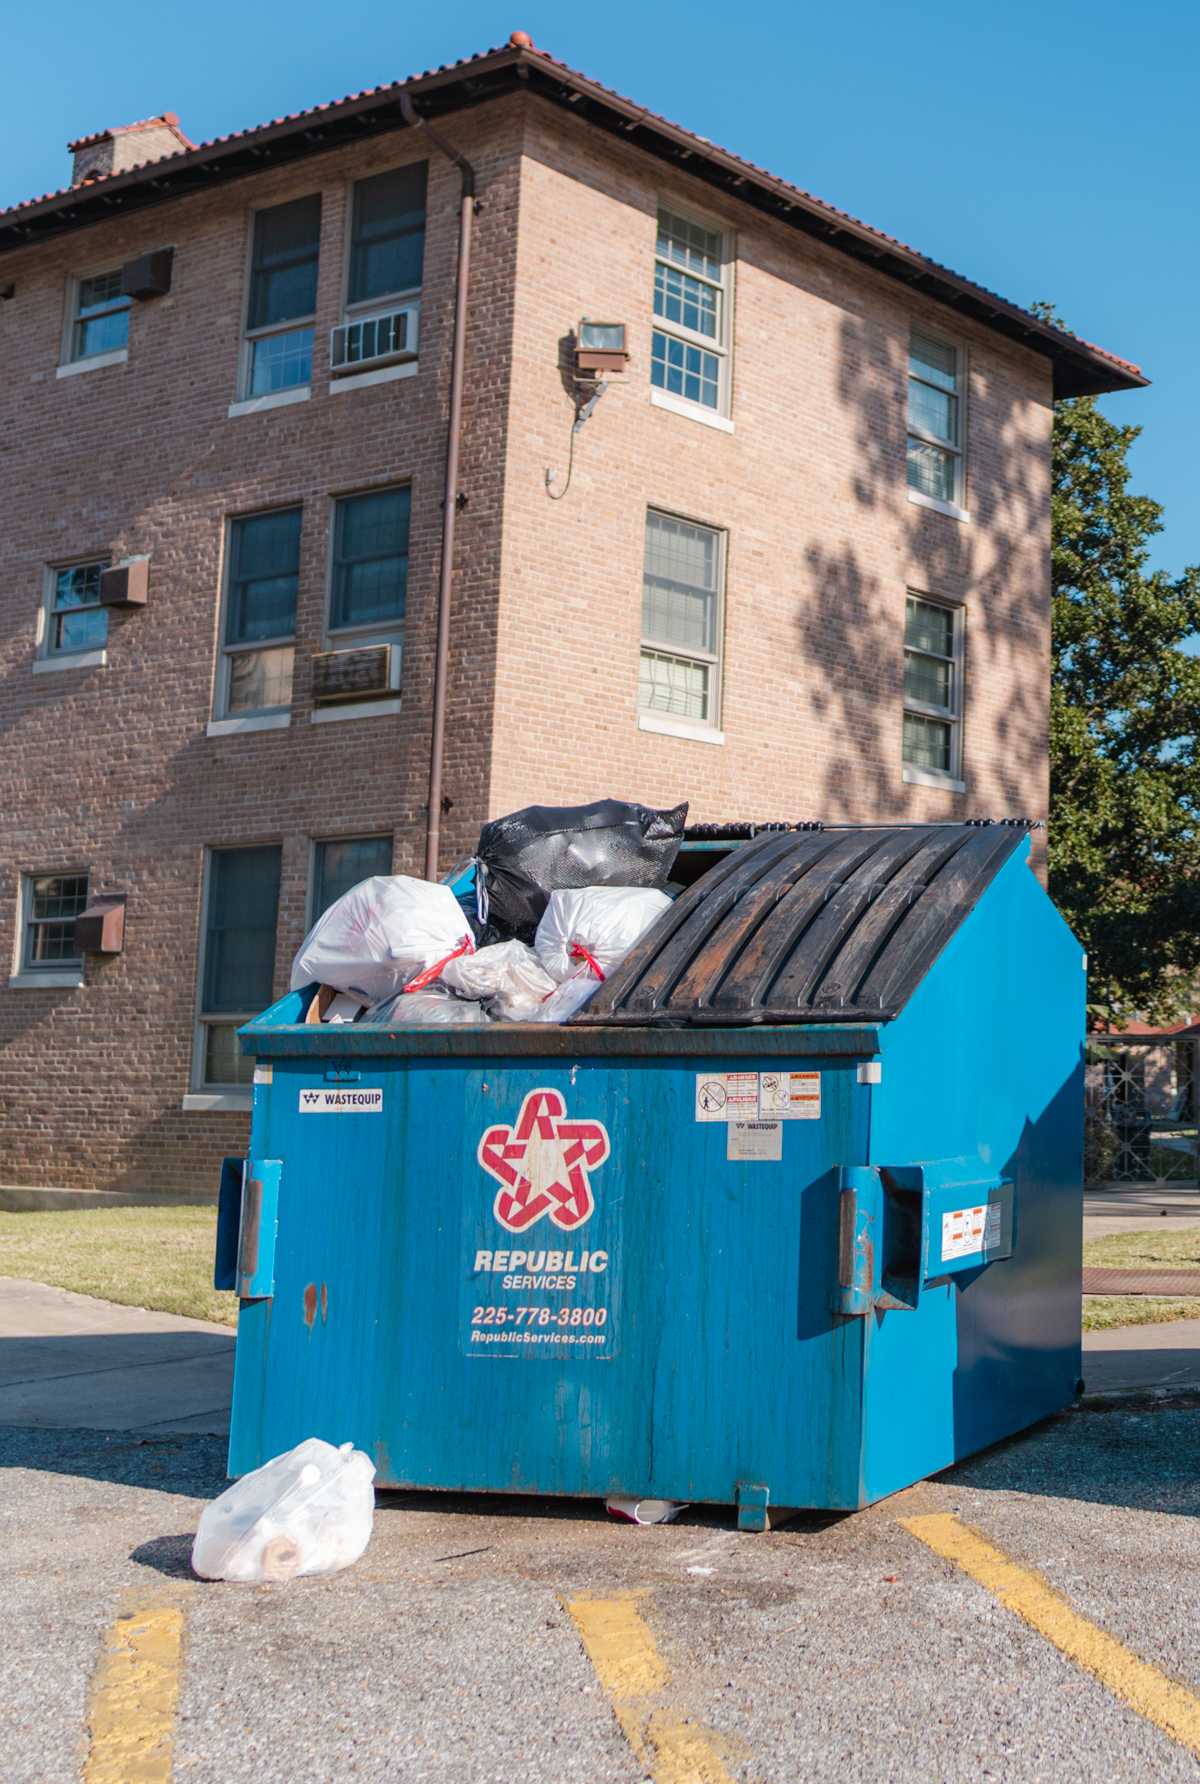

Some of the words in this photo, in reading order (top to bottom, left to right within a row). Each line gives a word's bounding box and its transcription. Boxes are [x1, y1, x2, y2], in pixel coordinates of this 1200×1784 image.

[325, 1094, 381, 1105] WASTEQUIP
[474, 1250, 609, 1273] REPUBLIC
[502, 1275, 577, 1290] SERVICES
[472, 1306, 608, 1326] 225-778-3800
[471, 1330, 606, 1344] RepublicServices.com
